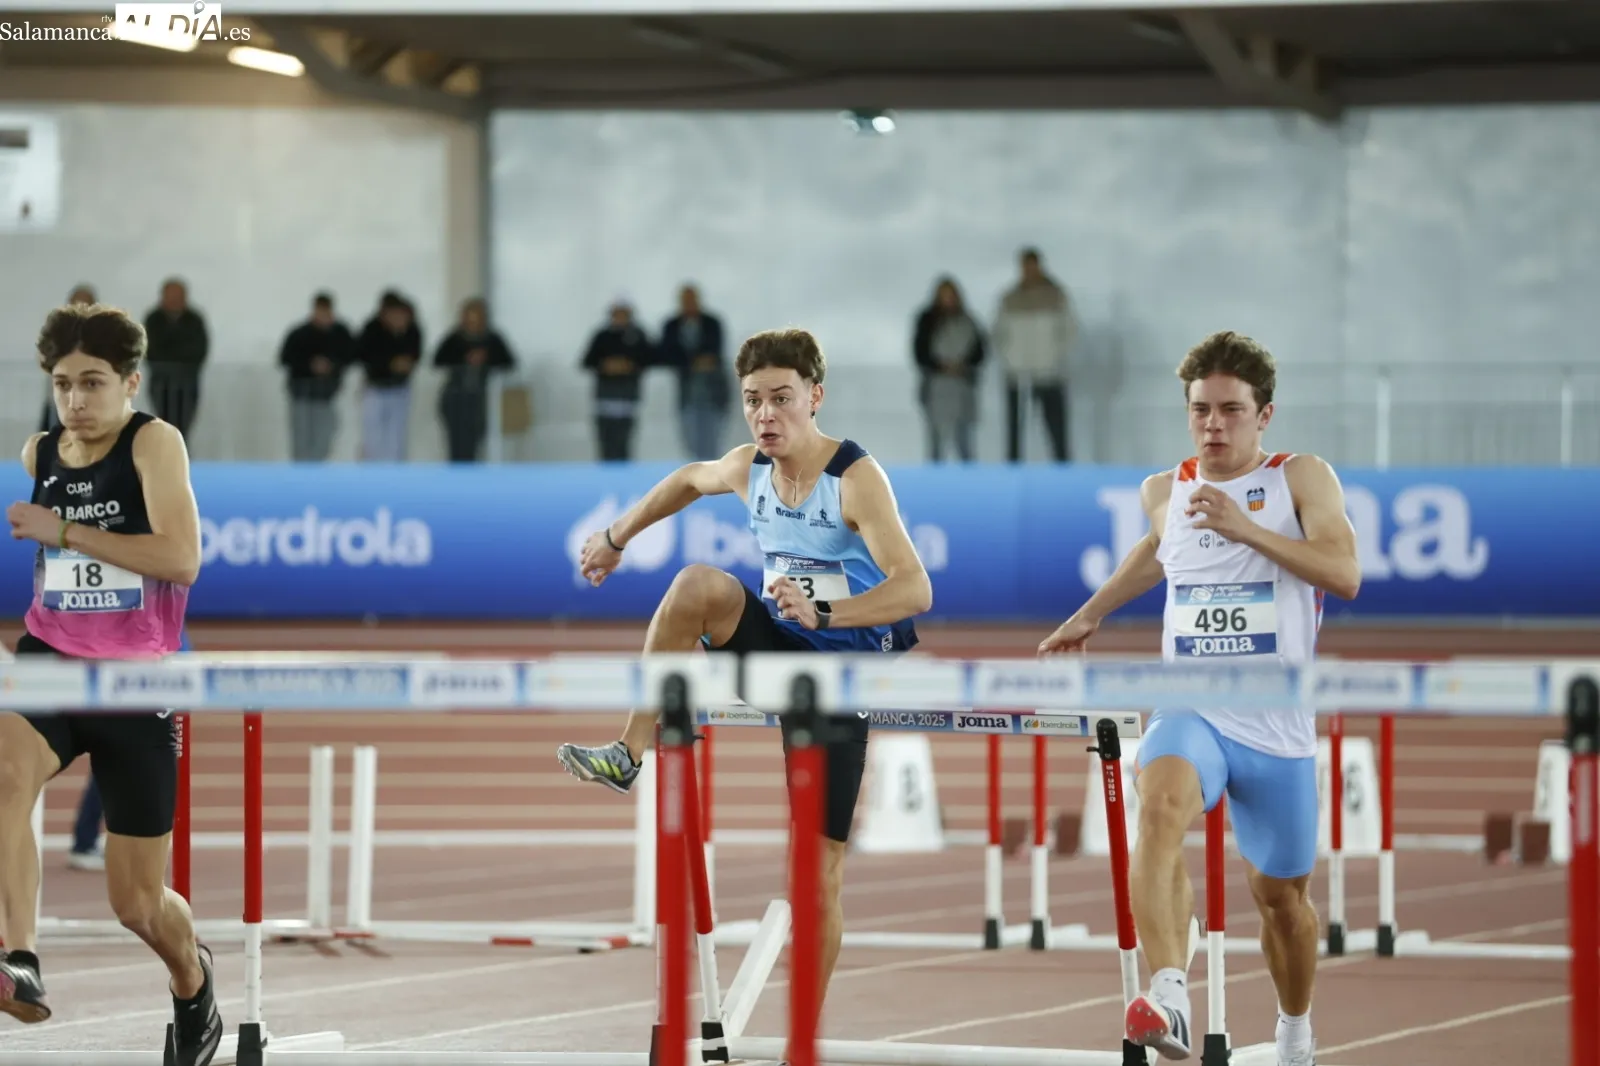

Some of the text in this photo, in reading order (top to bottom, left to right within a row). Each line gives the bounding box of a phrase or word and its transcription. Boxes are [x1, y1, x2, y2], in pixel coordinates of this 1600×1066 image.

[65, 500, 121, 520] BARCO
[72, 563, 103, 588] 18
[58, 591, 121, 610] Joma
[1194, 606, 1247, 633] 496
[1191, 636, 1256, 656] Joma
[917, 713, 946, 727] 2025
[957, 715, 1009, 729] Joma
